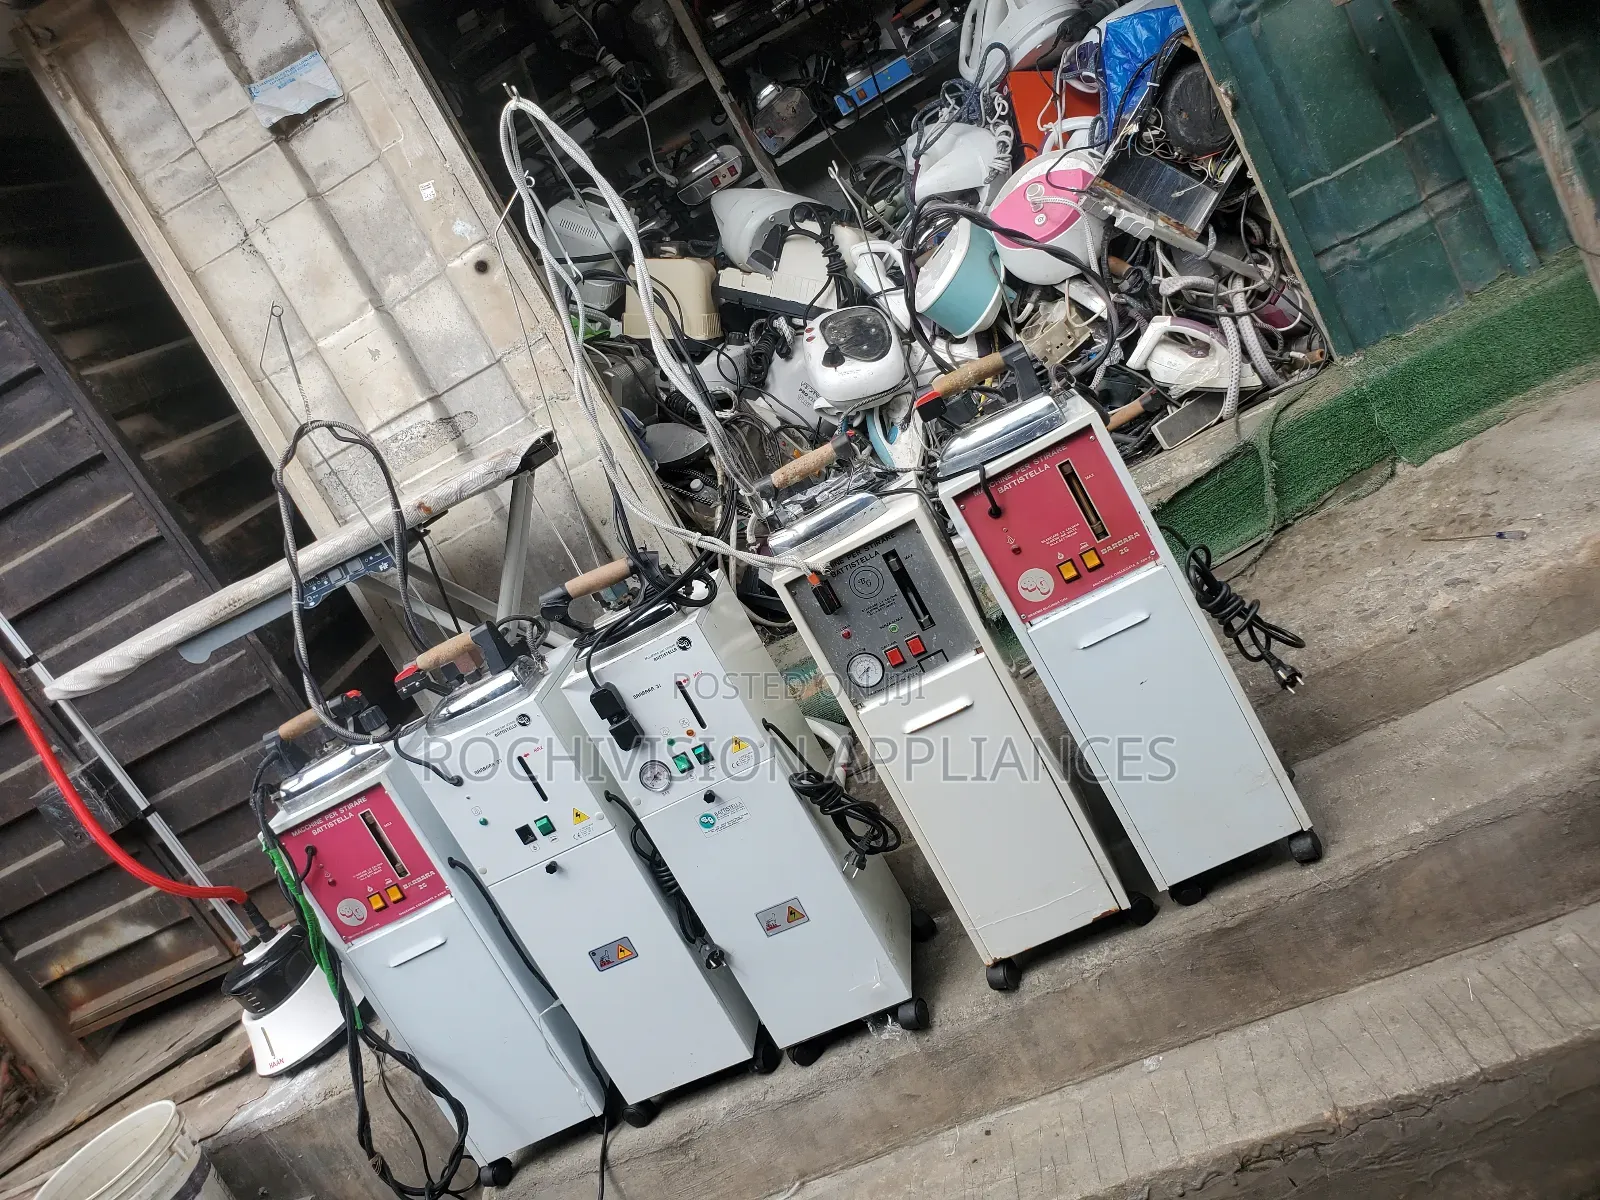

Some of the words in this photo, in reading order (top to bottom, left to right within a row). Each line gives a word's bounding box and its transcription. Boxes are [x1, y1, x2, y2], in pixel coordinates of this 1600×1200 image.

[973, 472, 1014, 497] MACHINE
[1015, 463, 1033, 476] PER
[1033, 444, 1068, 465] STIRARE
[997, 463, 1050, 494] BATTISTELLA
[1084, 473, 1095, 481] MAX
[847, 550, 863, 561] PER
[863, 532, 897, 552] STIRARE
[1100, 531, 1141, 555] BARBARA
[830, 550, 880, 578] BATTISTELLA
[291, 817, 324, 837] MACCHINE
[324, 811, 339, 821] PER
[338, 795, 368, 814] STIRARE
[311, 812, 354, 836] BATTISTELLA
[402, 870, 436, 890] BARBARA
